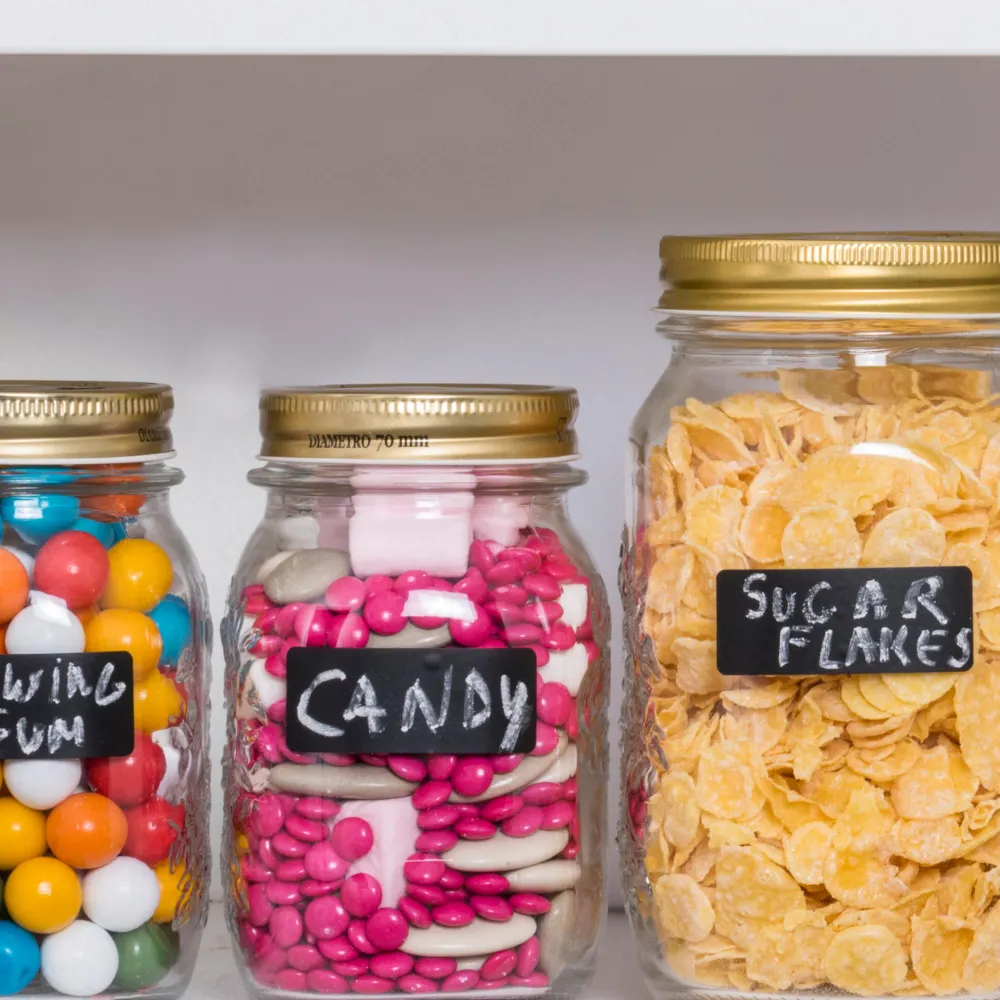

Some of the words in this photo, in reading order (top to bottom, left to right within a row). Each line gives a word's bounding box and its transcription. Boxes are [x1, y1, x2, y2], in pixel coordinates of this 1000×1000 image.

[308, 434, 371, 449] DIAMETRO
[375, 434, 394, 452] 70
[398, 434, 429, 448] mm
[778, 624, 972, 670] FLAKES
[296, 664, 533, 753] CANDY
